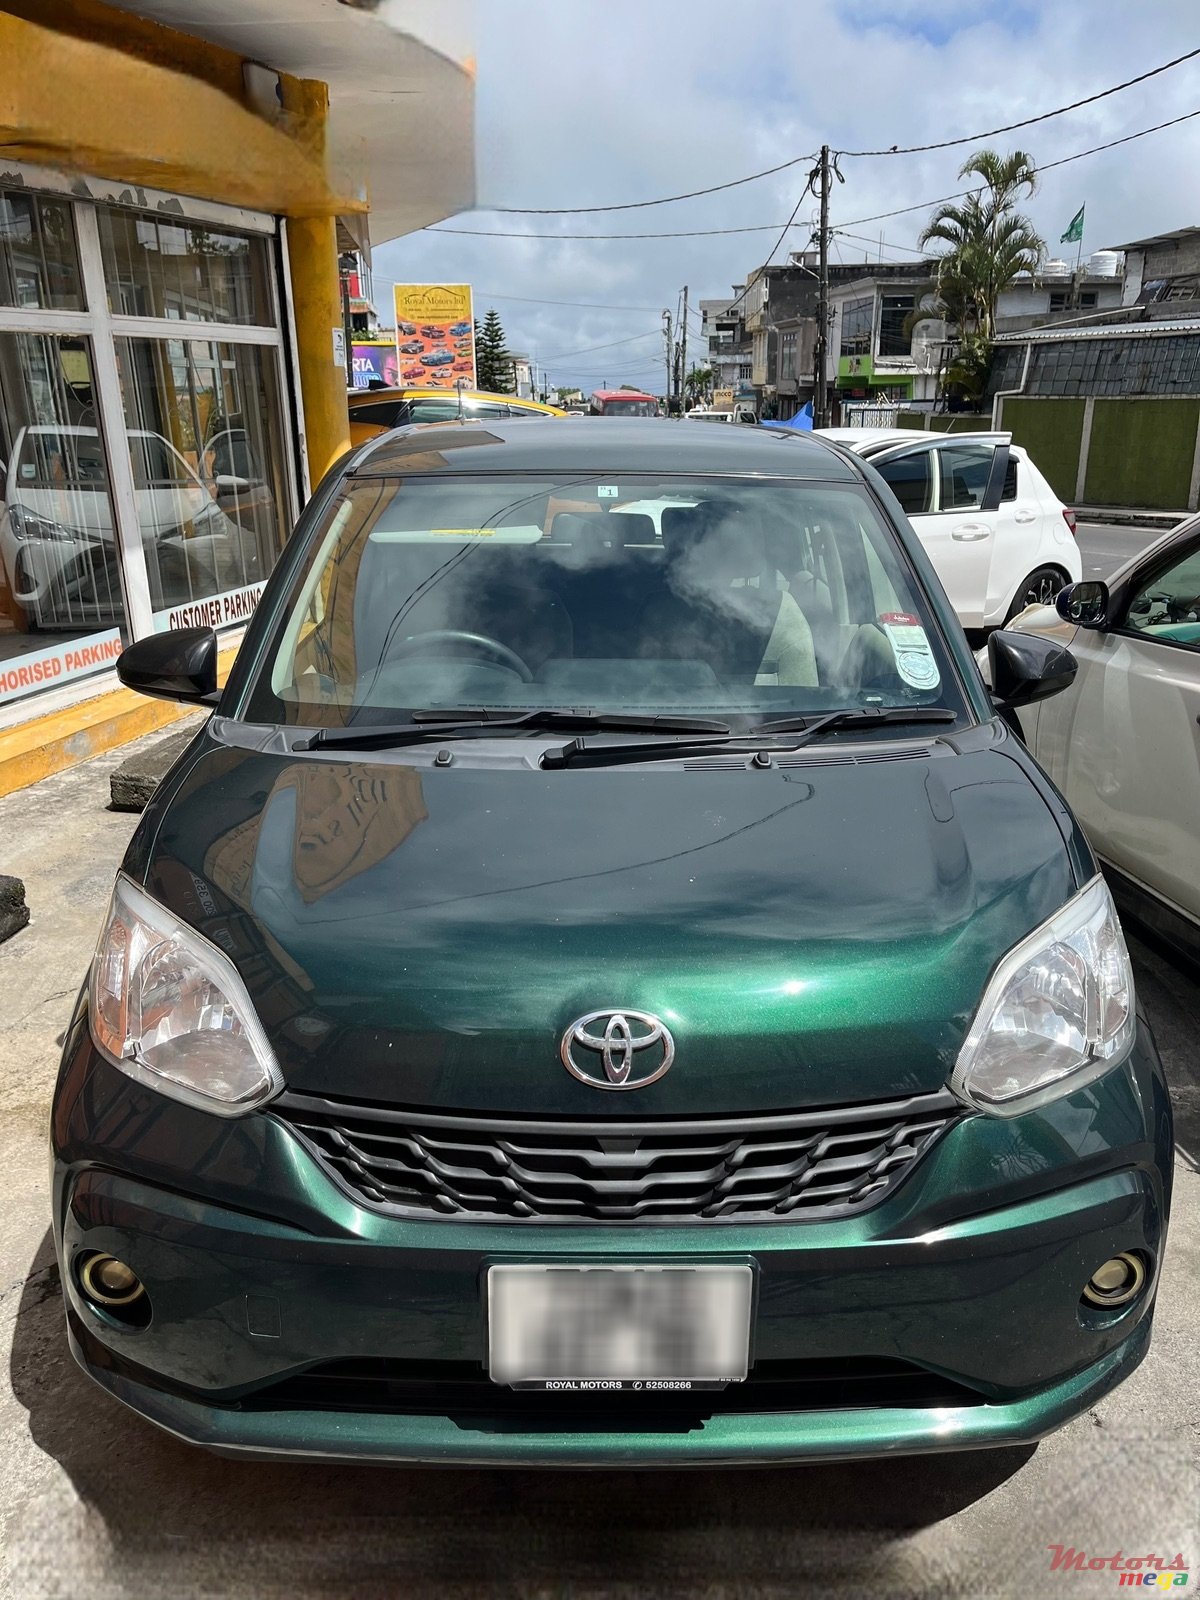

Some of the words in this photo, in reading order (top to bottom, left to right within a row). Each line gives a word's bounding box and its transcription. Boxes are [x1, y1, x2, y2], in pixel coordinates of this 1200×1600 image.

[404, 296, 425, 306] Royal
[426, 296, 453, 305] Motors
[169, 599, 222, 631] CUSTOMER
[64, 638, 122, 672] PARKING
[545, 1381, 578, 1389] ROYAL
[580, 1381, 622, 1389] MOTORS
[645, 1381, 692, 1389] 52508266
